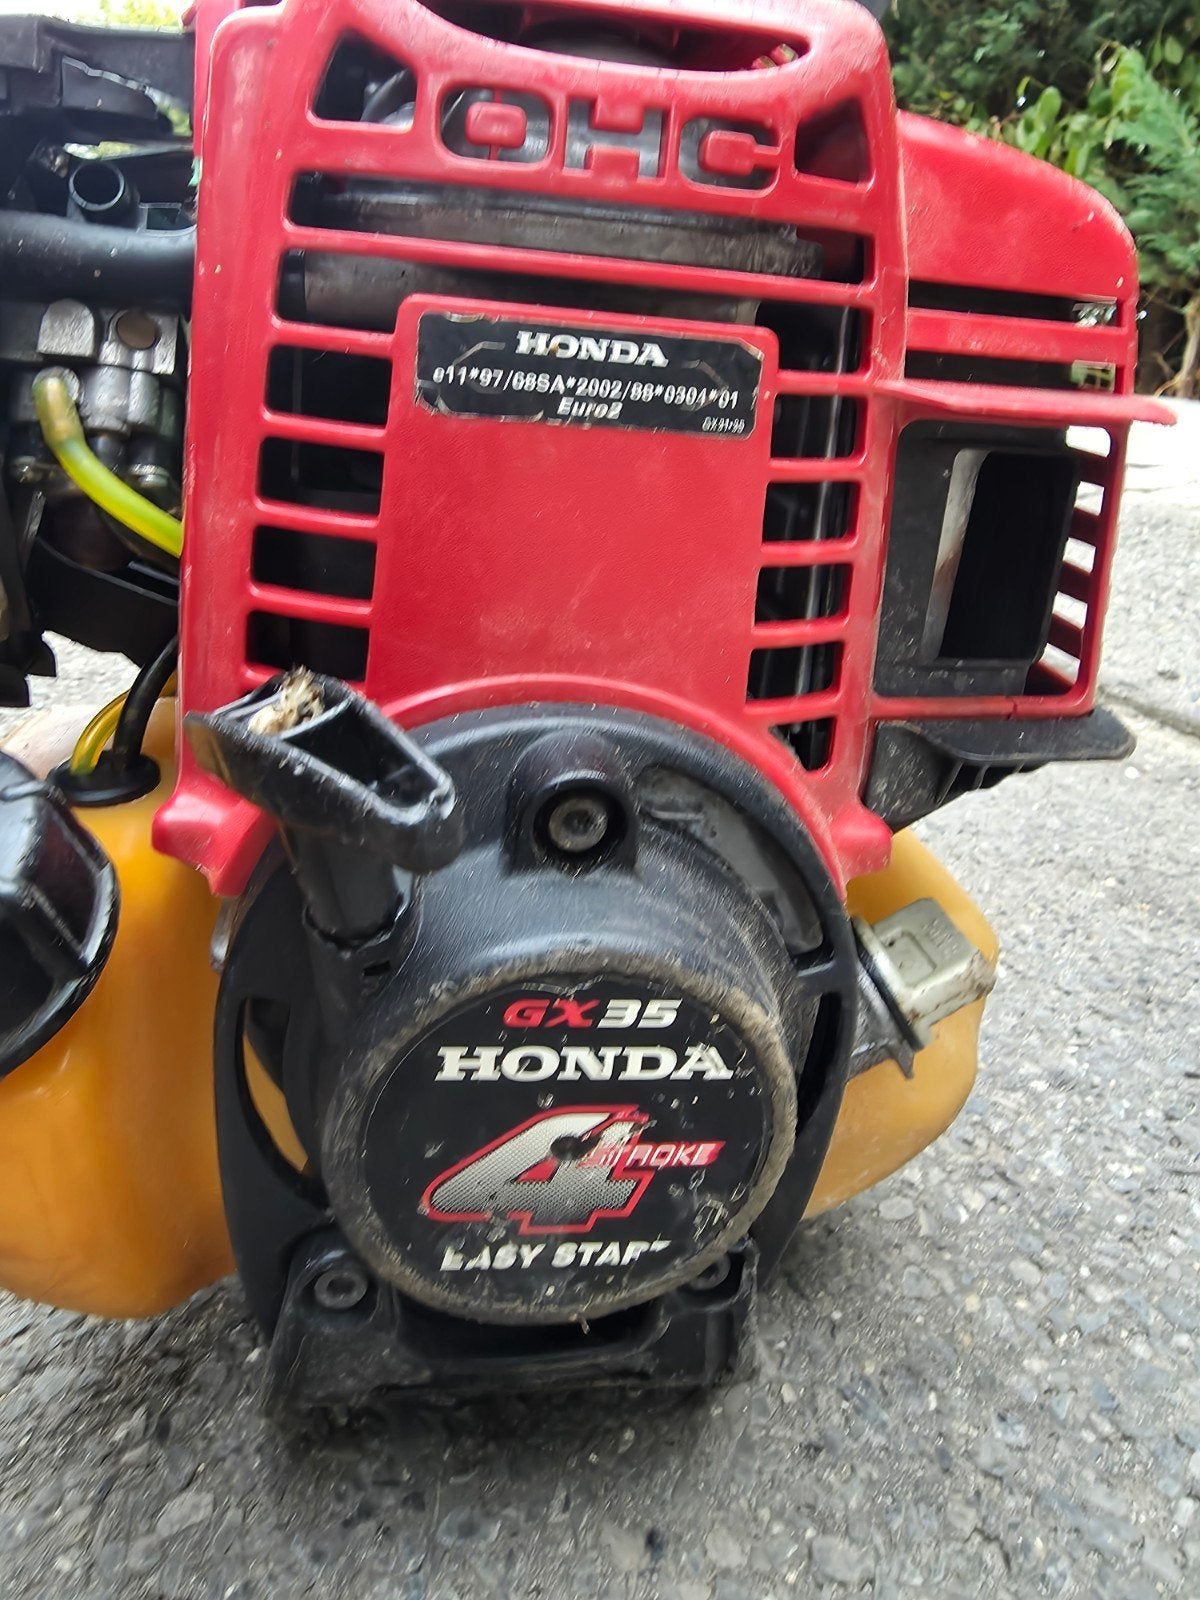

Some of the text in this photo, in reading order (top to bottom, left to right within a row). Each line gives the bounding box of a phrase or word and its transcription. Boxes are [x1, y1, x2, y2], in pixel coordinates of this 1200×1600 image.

[439, 87, 782, 191] OHC
[514, 330, 670, 368] HONDA
[556, 397, 623, 420] Euro2
[503, 998, 683, 1028] GX35
[434, 1045, 734, 1082] HONDA
[420, 1104, 656, 1236] 4
